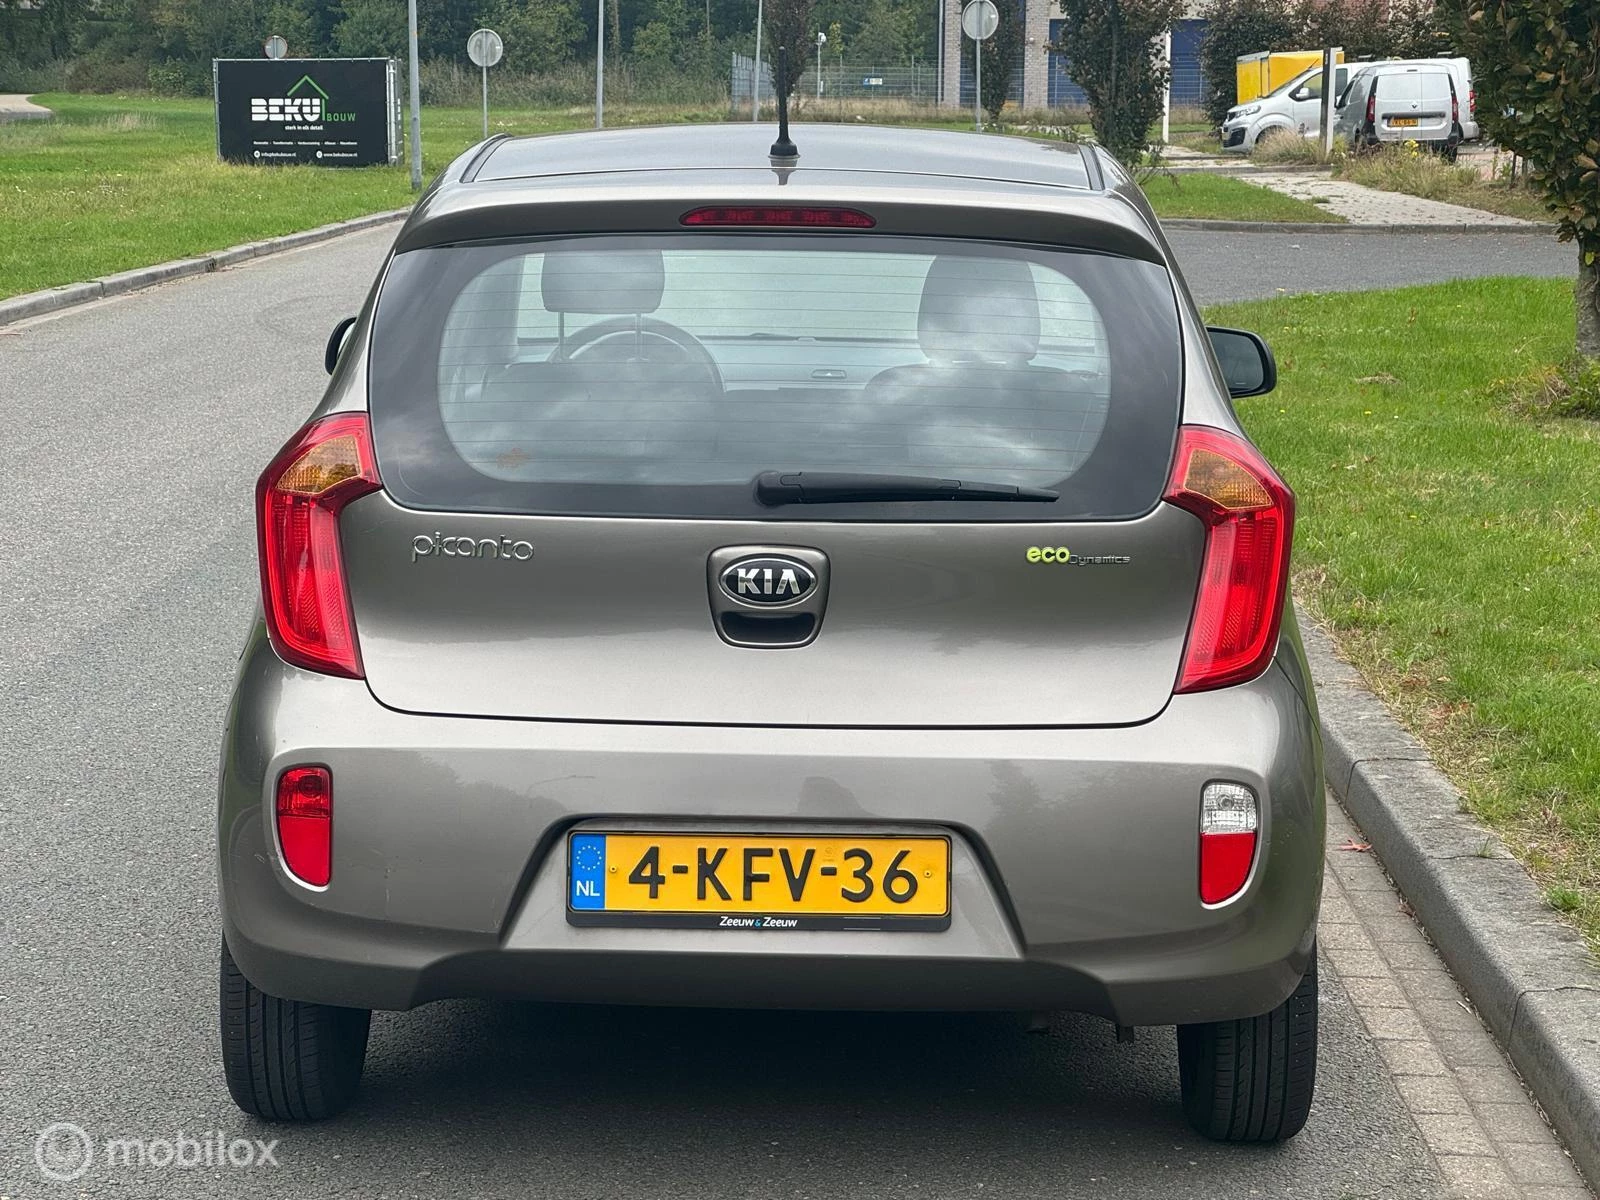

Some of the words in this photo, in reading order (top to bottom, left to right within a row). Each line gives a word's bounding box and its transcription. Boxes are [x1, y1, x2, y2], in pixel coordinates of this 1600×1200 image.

[251, 98, 320, 121] BEKU
[326, 113, 356, 122] BOUW
[411, 531, 534, 562] picanto
[1026, 546, 1070, 563] eco
[737, 568, 800, 594] KIA
[628, 846, 918, 904] 4-KFV-36
[576, 881, 600, 897] NL
[719, 916, 754, 926] Zeeuw
[754, 919, 760, 927] &
[762, 917, 797, 927] Zeeuw
